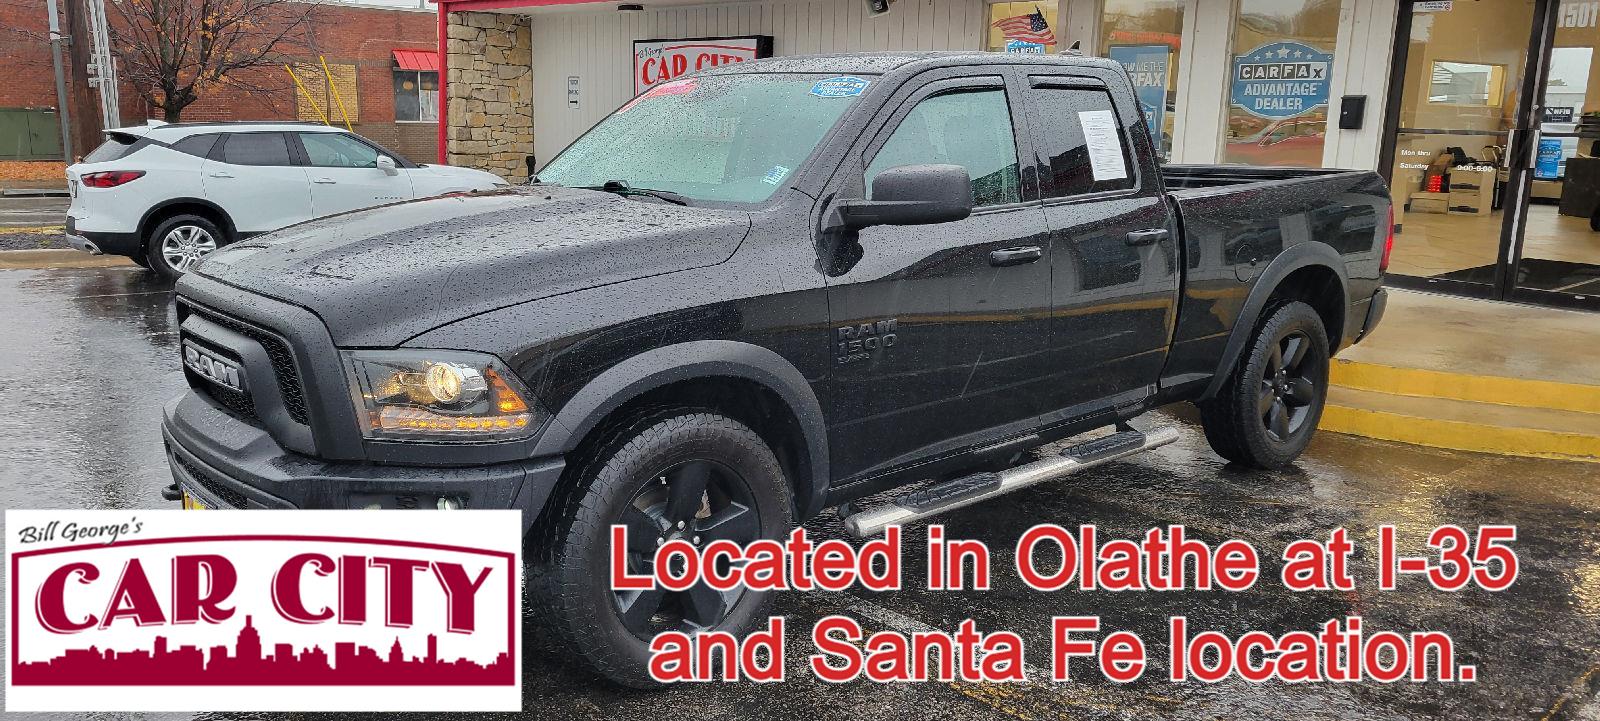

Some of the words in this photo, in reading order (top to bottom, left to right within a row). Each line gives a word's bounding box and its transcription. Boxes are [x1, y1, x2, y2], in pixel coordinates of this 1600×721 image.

[1557, 2, 1597, 28] 1501
[1150, 61, 1165, 72] THE
[1241, 63, 1325, 79] CARFAX
[1244, 82, 1318, 96] ADVANTAGE
[1254, 97, 1304, 110] DEALER
[1400, 162, 1430, 171] Saturday
[837, 318, 898, 341] RAM
[838, 333, 897, 355] 1500
[185, 345, 241, 388] RAM
